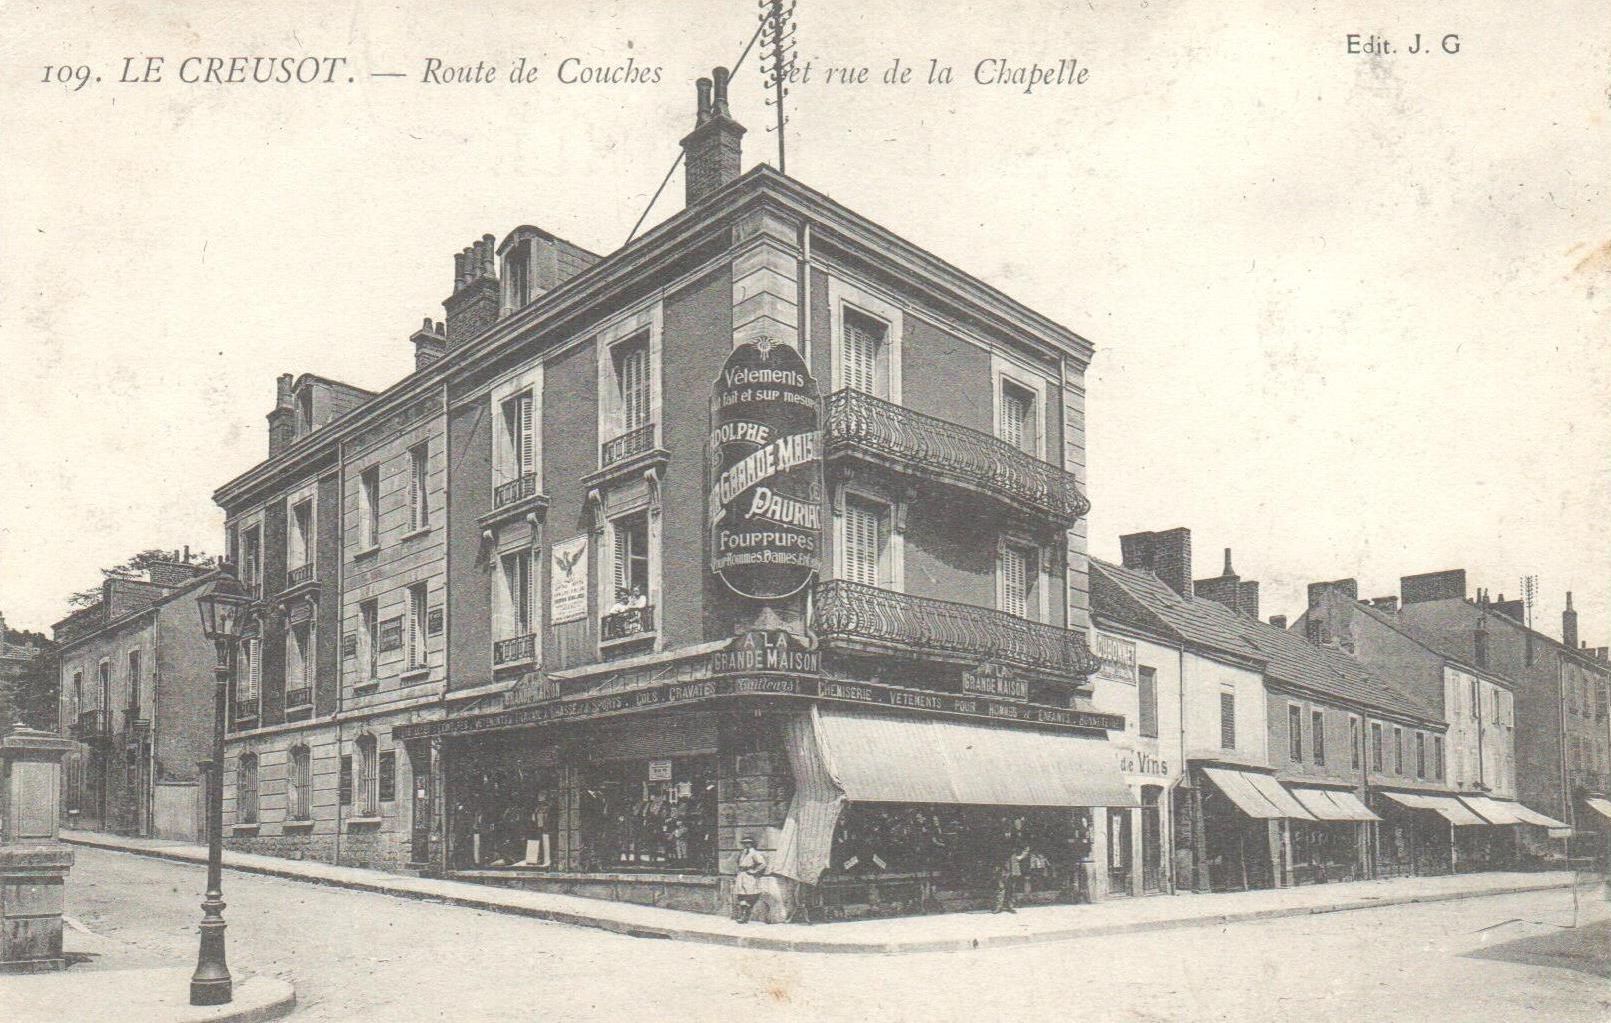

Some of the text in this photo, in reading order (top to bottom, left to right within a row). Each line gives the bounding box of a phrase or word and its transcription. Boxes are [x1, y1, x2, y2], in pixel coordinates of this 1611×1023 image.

[741, 388, 752, 402] et
[720, 443, 777, 505] GRANDE
[743, 631, 787, 649] A LA
[714, 648, 817, 672] GRANDE MAISON
[669, 681, 717, 702] CRAVATES
[963, 672, 996, 693] GRANDE
[818, 680, 873, 700] CHEMISERIE
[955, 699, 976, 713] POUR
[1120, 751, 1168, 776] de Vins
